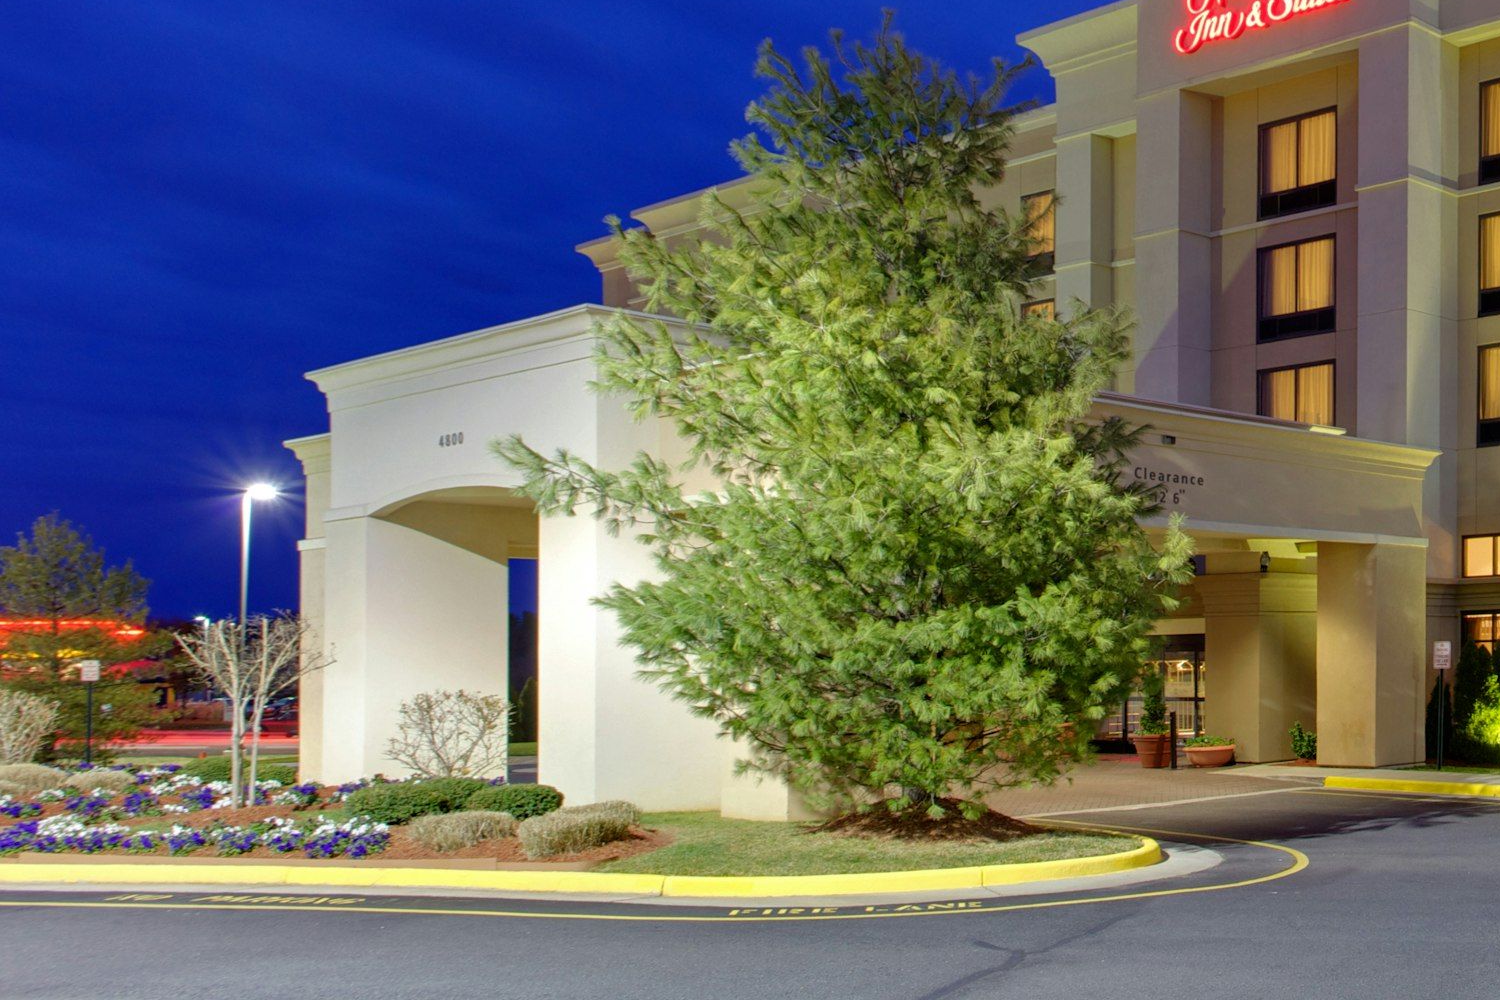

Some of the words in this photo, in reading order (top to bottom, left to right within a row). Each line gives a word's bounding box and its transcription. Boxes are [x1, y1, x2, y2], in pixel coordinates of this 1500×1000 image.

[1174, 9, 1245, 53] Inn
[1246, 0, 1269, 27] &
[438, 431, 464, 448] 4800
[1134, 466, 1205, 486] Clearance
[728, 907, 839, 916] FIRE
[865, 902, 982, 912] LANE
